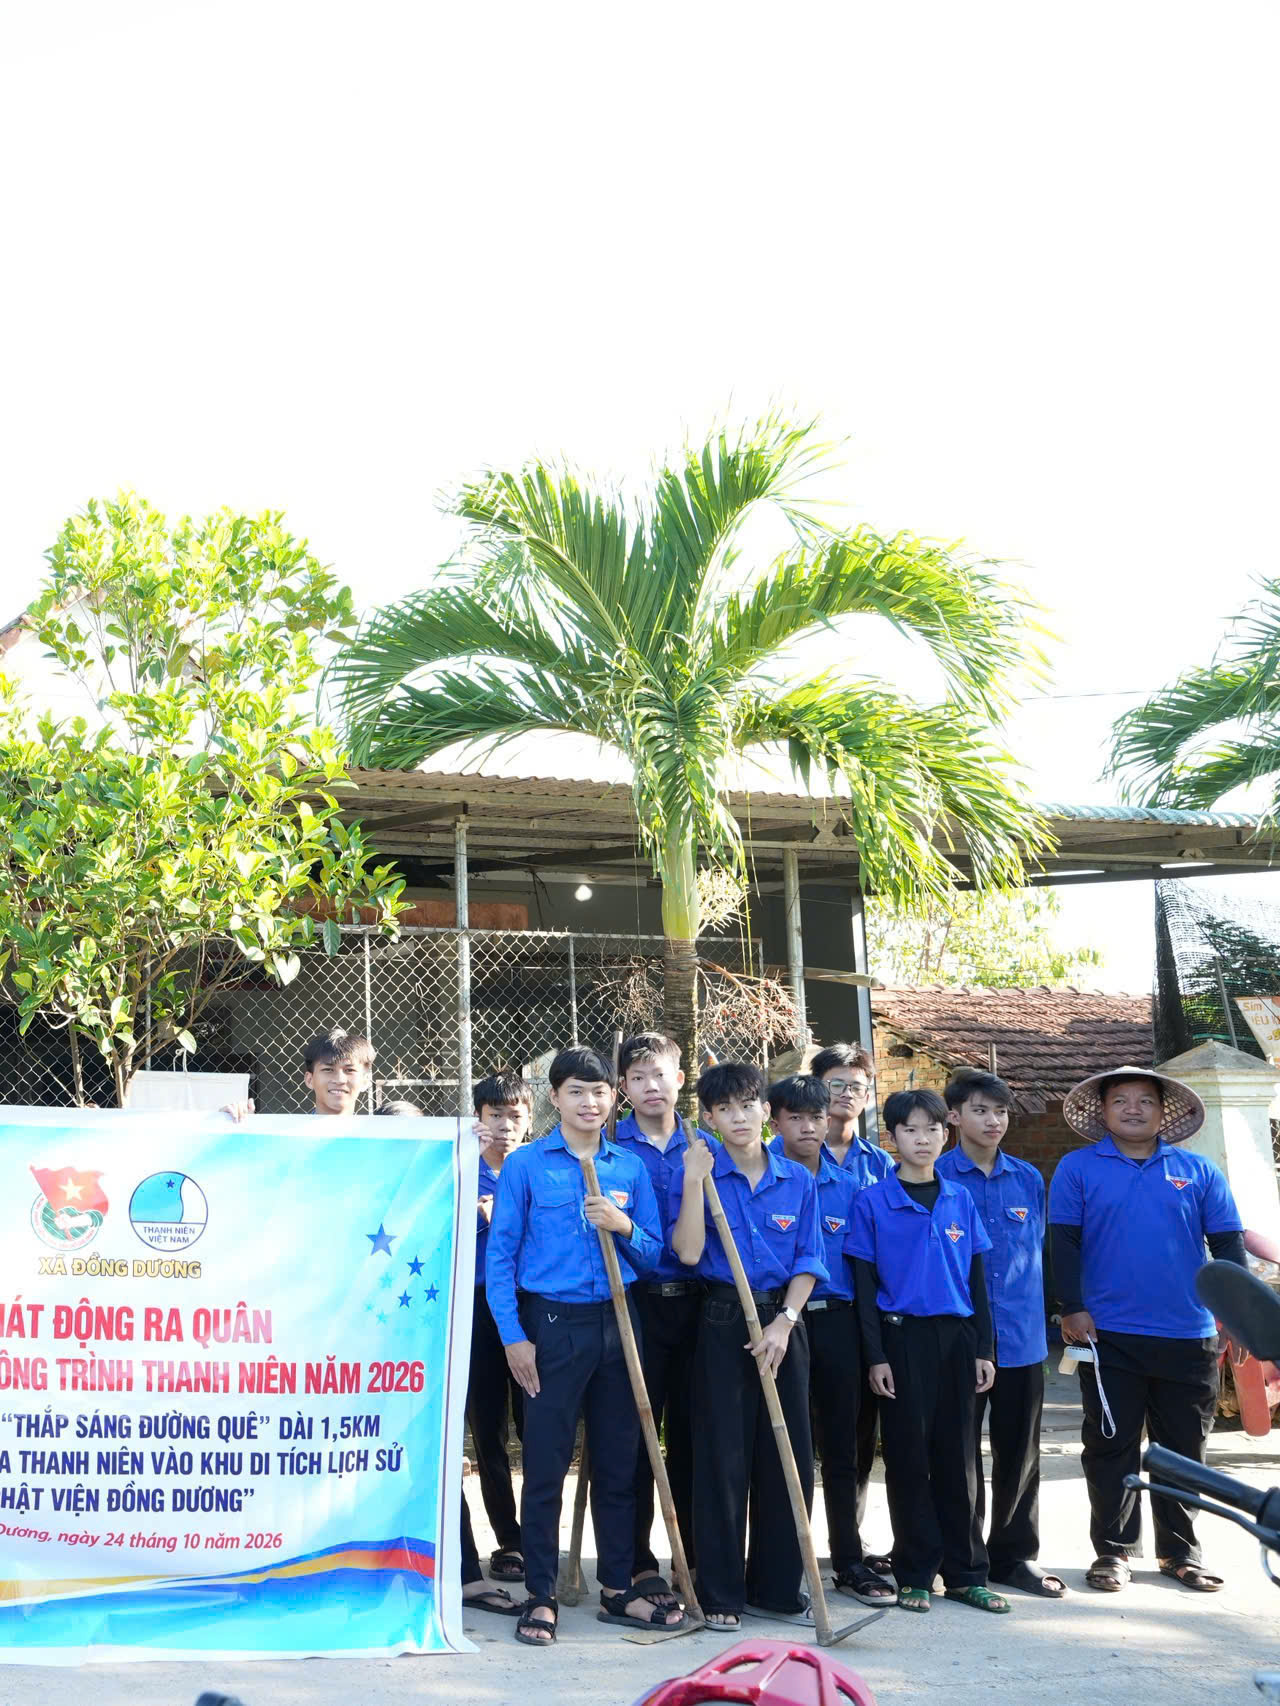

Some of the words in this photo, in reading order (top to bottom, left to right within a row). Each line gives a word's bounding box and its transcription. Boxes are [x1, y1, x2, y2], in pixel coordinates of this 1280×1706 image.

[143, 1226, 173, 1234] THANH
[174, 1224, 195, 1235] NIÊN
[148, 1235, 167, 1245] VIỆT
[170, 1236, 190, 1244] NAM
[38, 1253, 67, 1276] XÃ
[71, 1251, 129, 1277] ĐỒNG
[132, 1258, 202, 1279] DƯƠNG
[52, 1297, 134, 1349] ĐỘNG
[144, 1307, 184, 1342] RA
[192, 1301, 272, 1349] QUÂN
[55, 1351, 133, 1392] TRÌNH
[141, 1359, 230, 1394] THANH
[238, 1355, 297, 1395] NIÊN
[304, 1355, 361, 1395] NĂM
[367, 1360, 425, 1394] 2026
[75, 1409, 131, 1439] SÁNG
[138, 1409, 210, 1439] ĐƯỜNG
[279, 1411, 313, 1440] DÀI
[320, 1414, 381, 1443] 1,5KM
[18, 1450, 89, 1475] THANH
[96, 1446, 144, 1475] NIÊN
[151, 1446, 193, 1475] VÀO
[200, 1451, 243, 1475] KHU
[250, 1451, 270, 1475] DI
[277, 1447, 320, 1475] TÍCH
[327, 1449, 368, 1479] LỊCH
[375, 1441, 404, 1473] SỬ
[52, 1484, 100, 1517] VIỆN
[107, 1480, 165, 1513] ĐỒNG
[57, 1529, 100, 1547] ngày
[103, 1532, 125, 1547] 24
[129, 1532, 178, 1553] tháng
[182, 1533, 200, 1549] 10
[204, 1532, 241, 1549] năm
[245, 1533, 283, 1550] 2026
